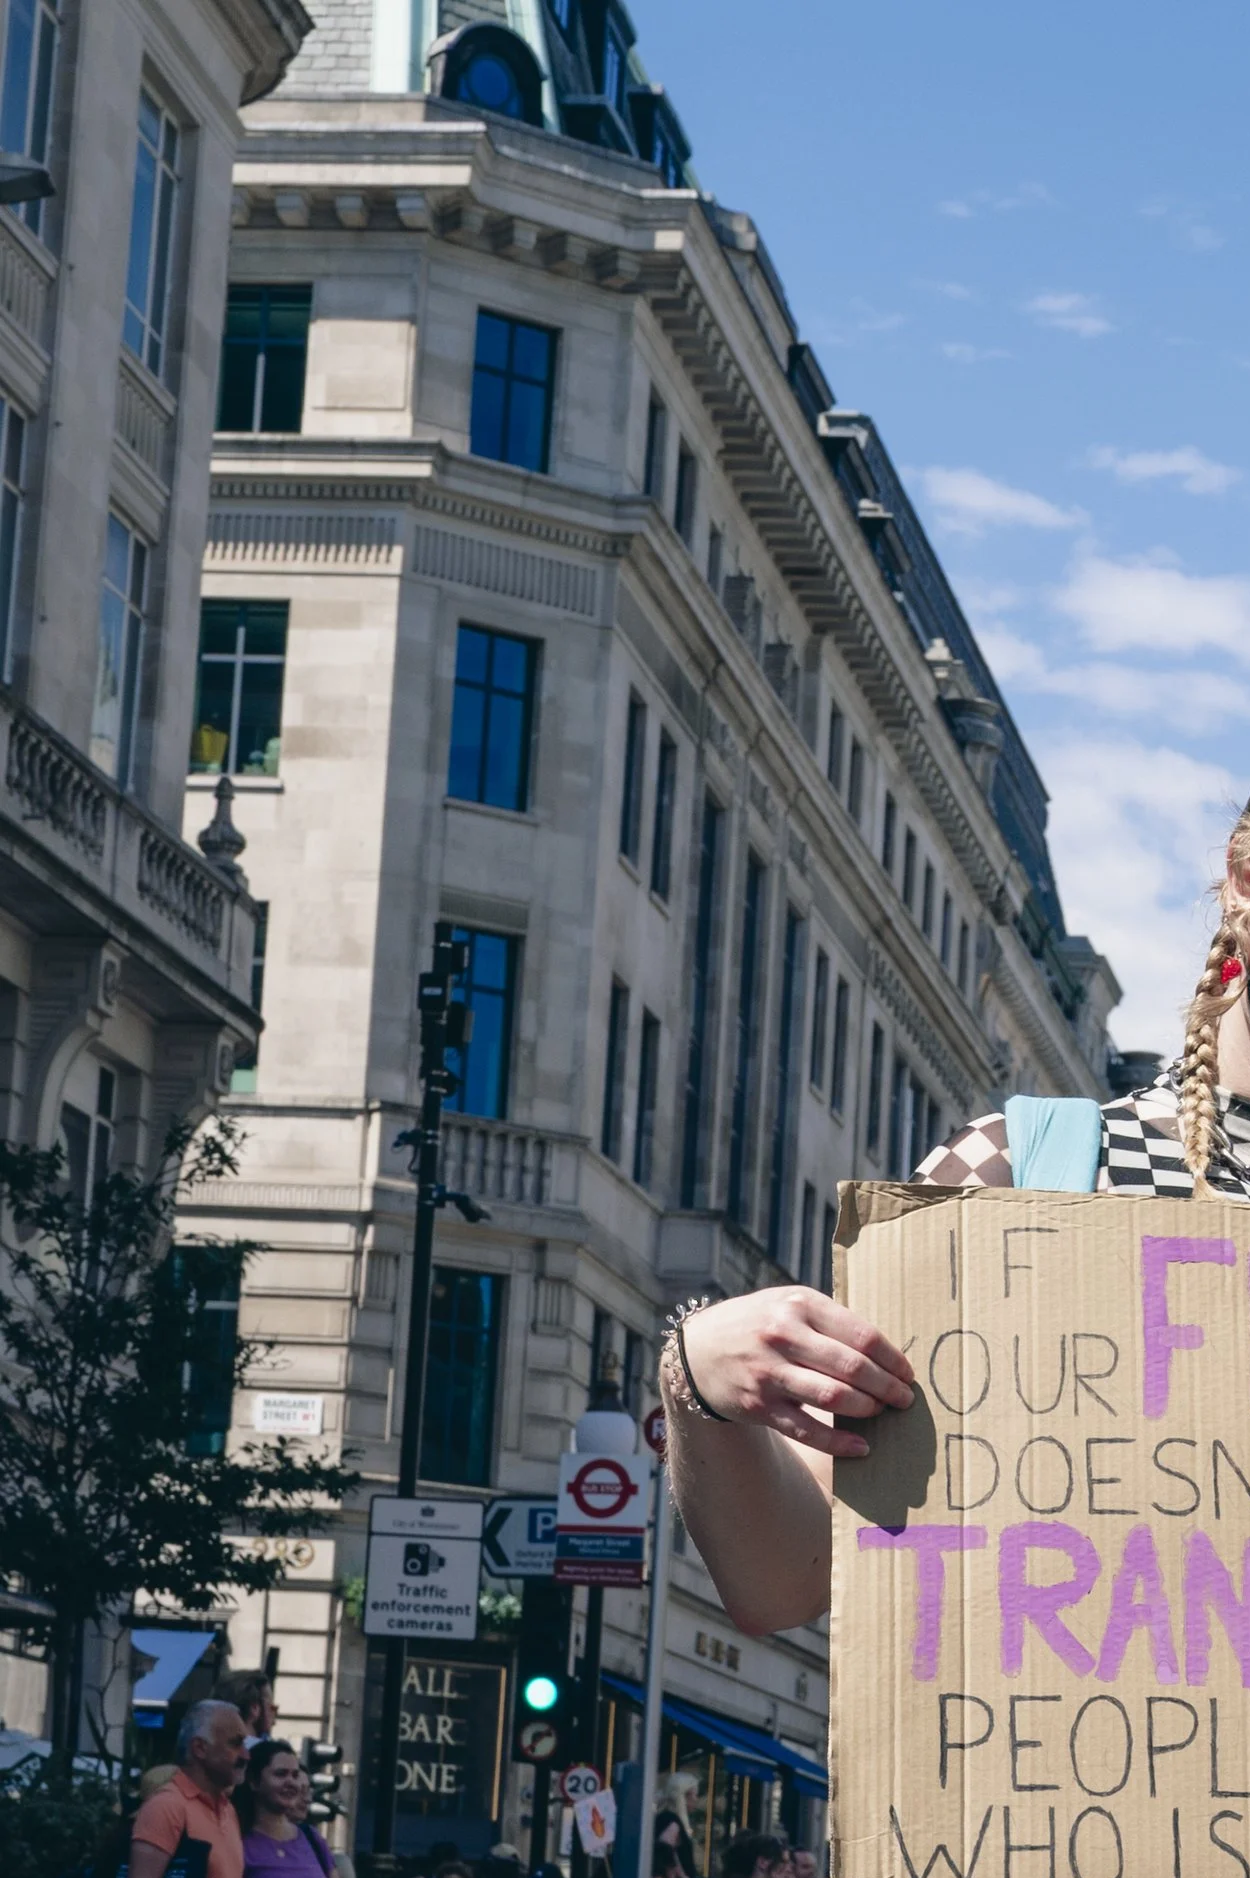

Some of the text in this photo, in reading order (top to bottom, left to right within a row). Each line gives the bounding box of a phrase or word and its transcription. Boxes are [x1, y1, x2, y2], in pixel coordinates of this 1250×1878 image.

[948, 1227, 1059, 1300] IF
[901, 1328, 1119, 1416] OUR
[263, 1399, 316, 1409] MARGARET
[263, 1410, 298, 1421] STREET
[581, 1483, 624, 1494] BUS STOP
[397, 1583, 449, 1600] Traffic
[371, 1599, 472, 1617] enforcement
[387, 1617, 454, 1633] cameras
[402, 1665, 458, 1699] ALL
[398, 1711, 457, 1746] BAR
[568, 1775, 598, 1795] 20
